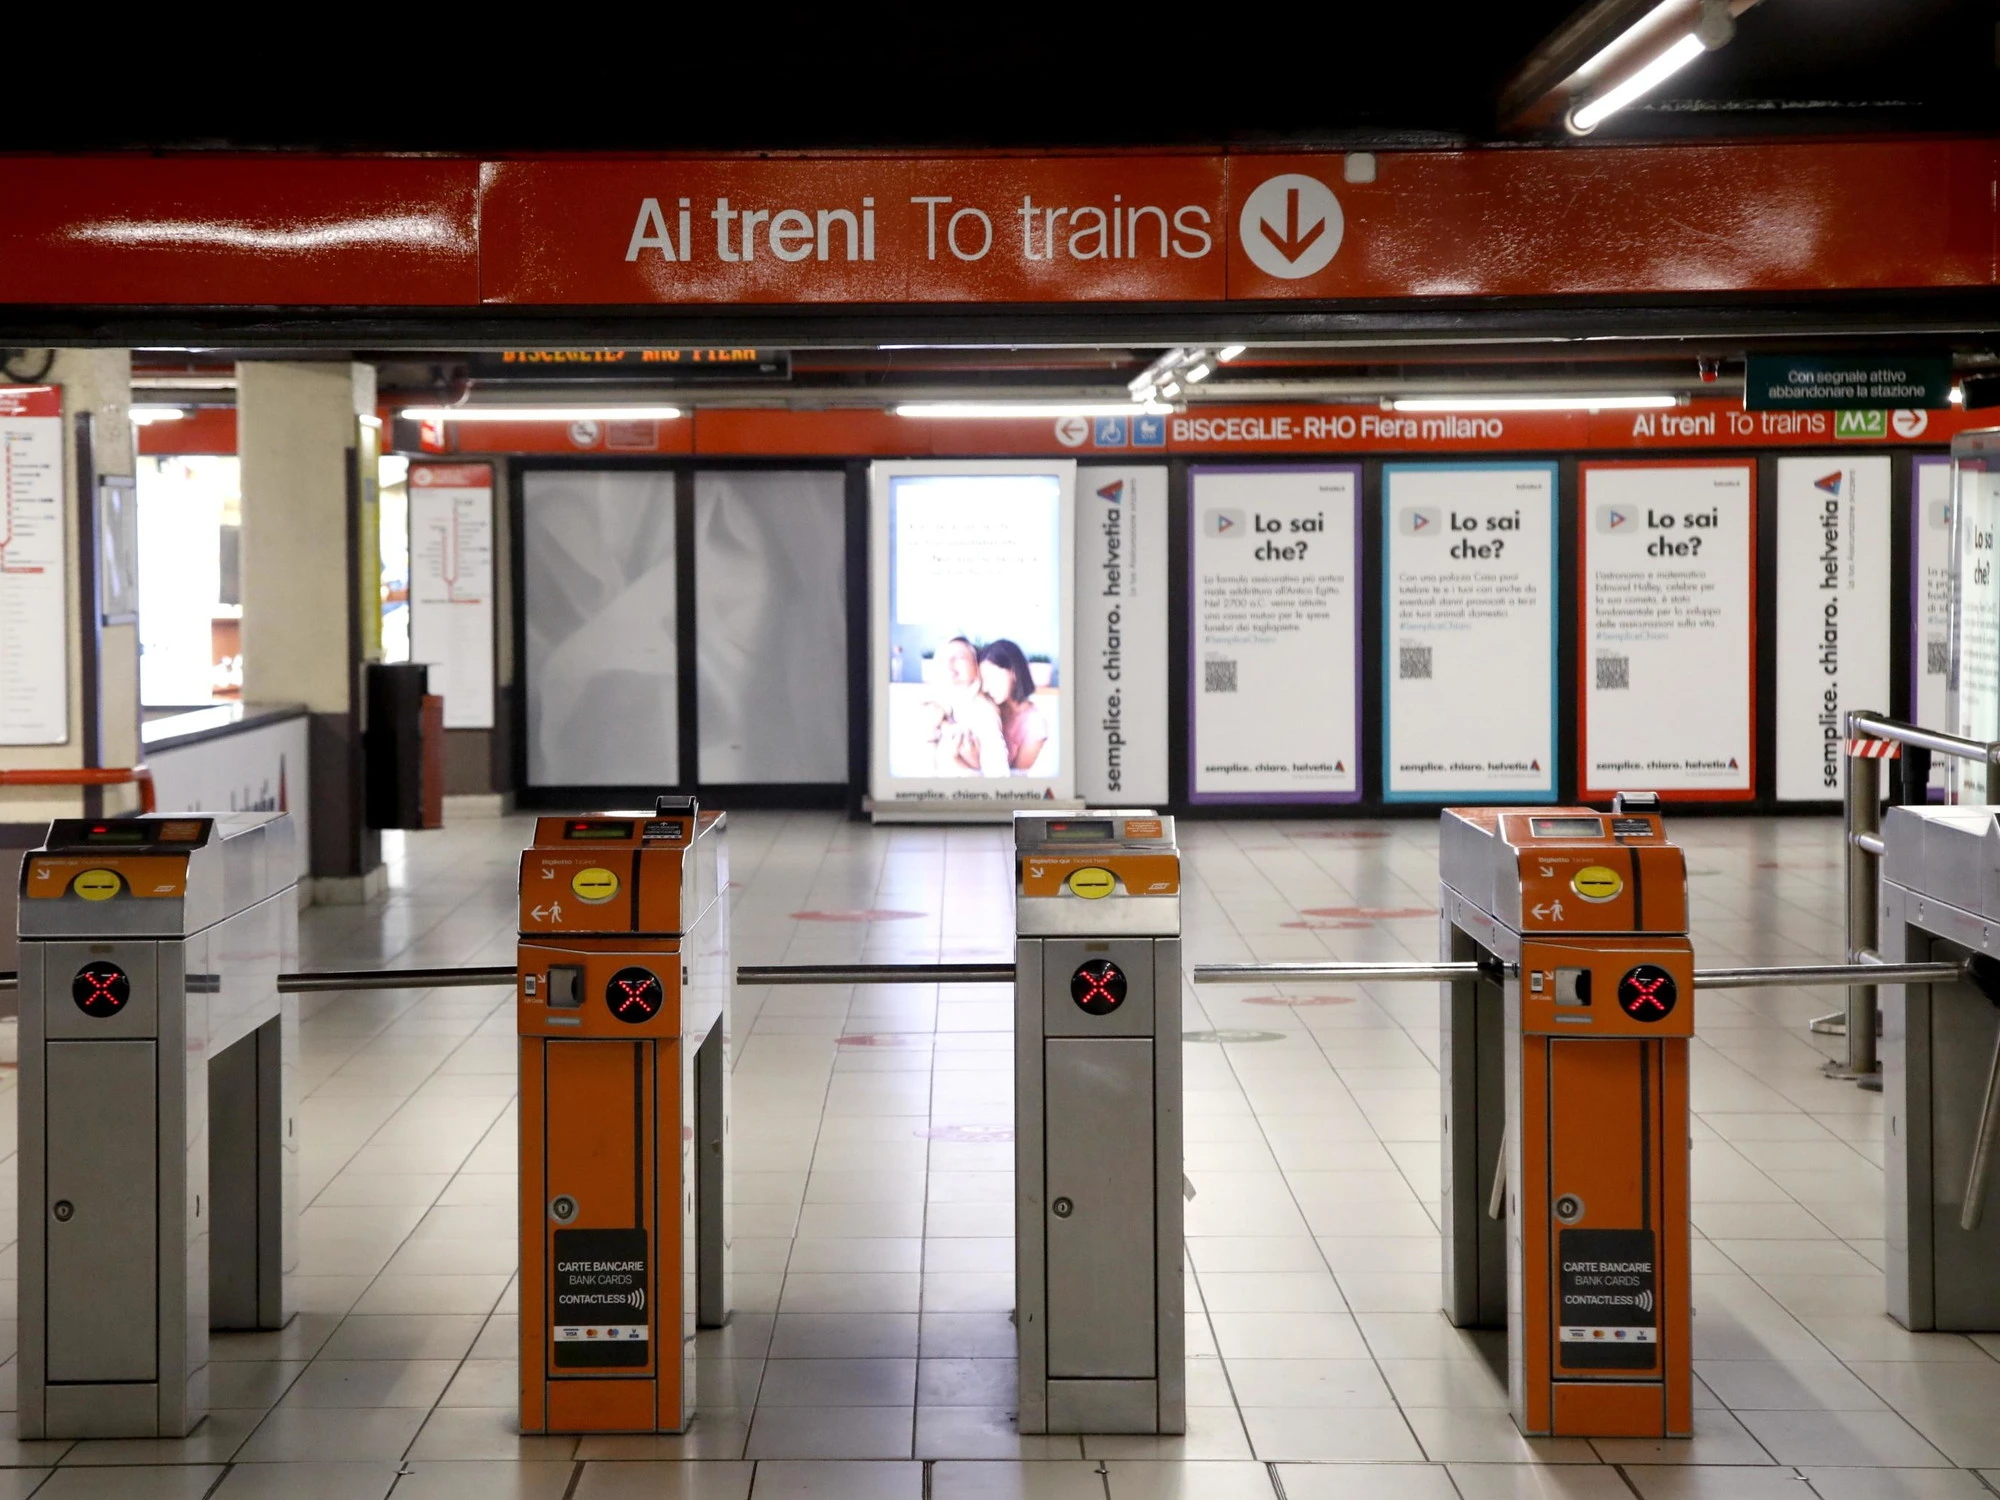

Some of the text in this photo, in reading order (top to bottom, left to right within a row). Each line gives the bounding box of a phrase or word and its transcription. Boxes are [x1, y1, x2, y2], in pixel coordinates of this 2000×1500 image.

[625, 194, 1212, 262] Ai treni To trains
[1788, 370, 1906, 387] Con segnale attivo
[1768, 384, 1926, 399] abbandonare la stazione
[1361, 415, 1417, 440] Fiera
[1421, 415, 1504, 440] milano
[1633, 410, 1881, 436] Ai treni To trains M2
[1254, 512, 1324, 534] Lo sai
[1450, 510, 1520, 532] Lo sai
[1647, 507, 1719, 530] Lo sai
[1647, 535, 1703, 558] che?
[1974, 523, 1994, 550] Lo sai
[1254, 540, 1309, 562] che?
[1449, 538, 1505, 560] che?
[1973, 557, 1991, 586] che?
[1103, 507, 1126, 792] semplice. chiaro. helvetia
[1819, 501, 1842, 788] semplice. chiaro. helvetia
[1292, 762, 1332, 773] helvetia
[1487, 761, 1528, 772] helvetia
[1685, 759, 1726, 770] helvetia
[996, 789, 1041, 800] helvetia
[557, 1261, 644, 1272] CARTE BANCARIE
[1563, 1262, 1652, 1273] CARTE BANCARIE
[569, 1274, 632, 1285] BANK CARDS
[1575, 1275, 1640, 1286] BANK CARDS
[559, 1294, 626, 1304] CONTACTLESS
[1565, 1295, 1634, 1305] CONTACTLESS
